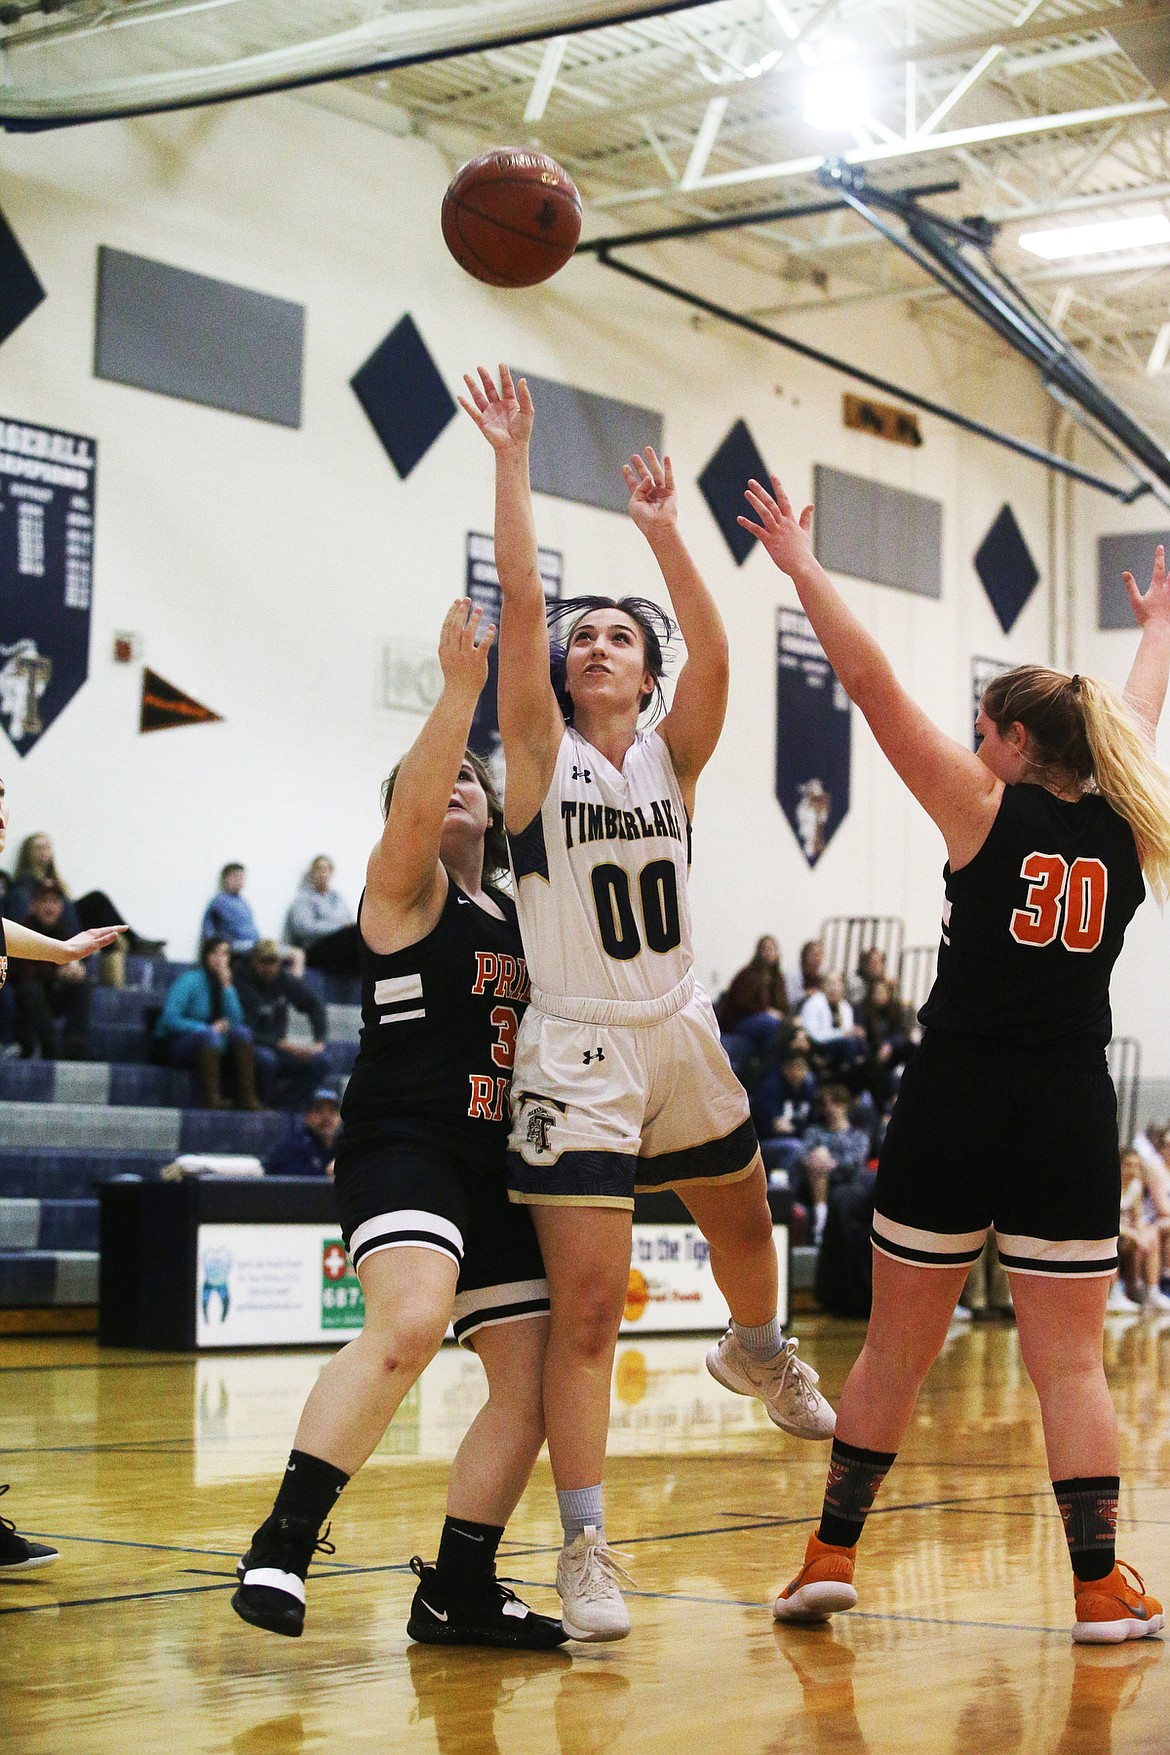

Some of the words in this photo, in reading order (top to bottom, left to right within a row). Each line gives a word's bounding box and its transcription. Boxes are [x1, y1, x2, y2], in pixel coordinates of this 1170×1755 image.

[590, 857, 681, 962] 00
[1009, 851, 1108, 953] 30
[490, 1005, 519, 1071] 3
[467, 1074, 513, 1121] RI
